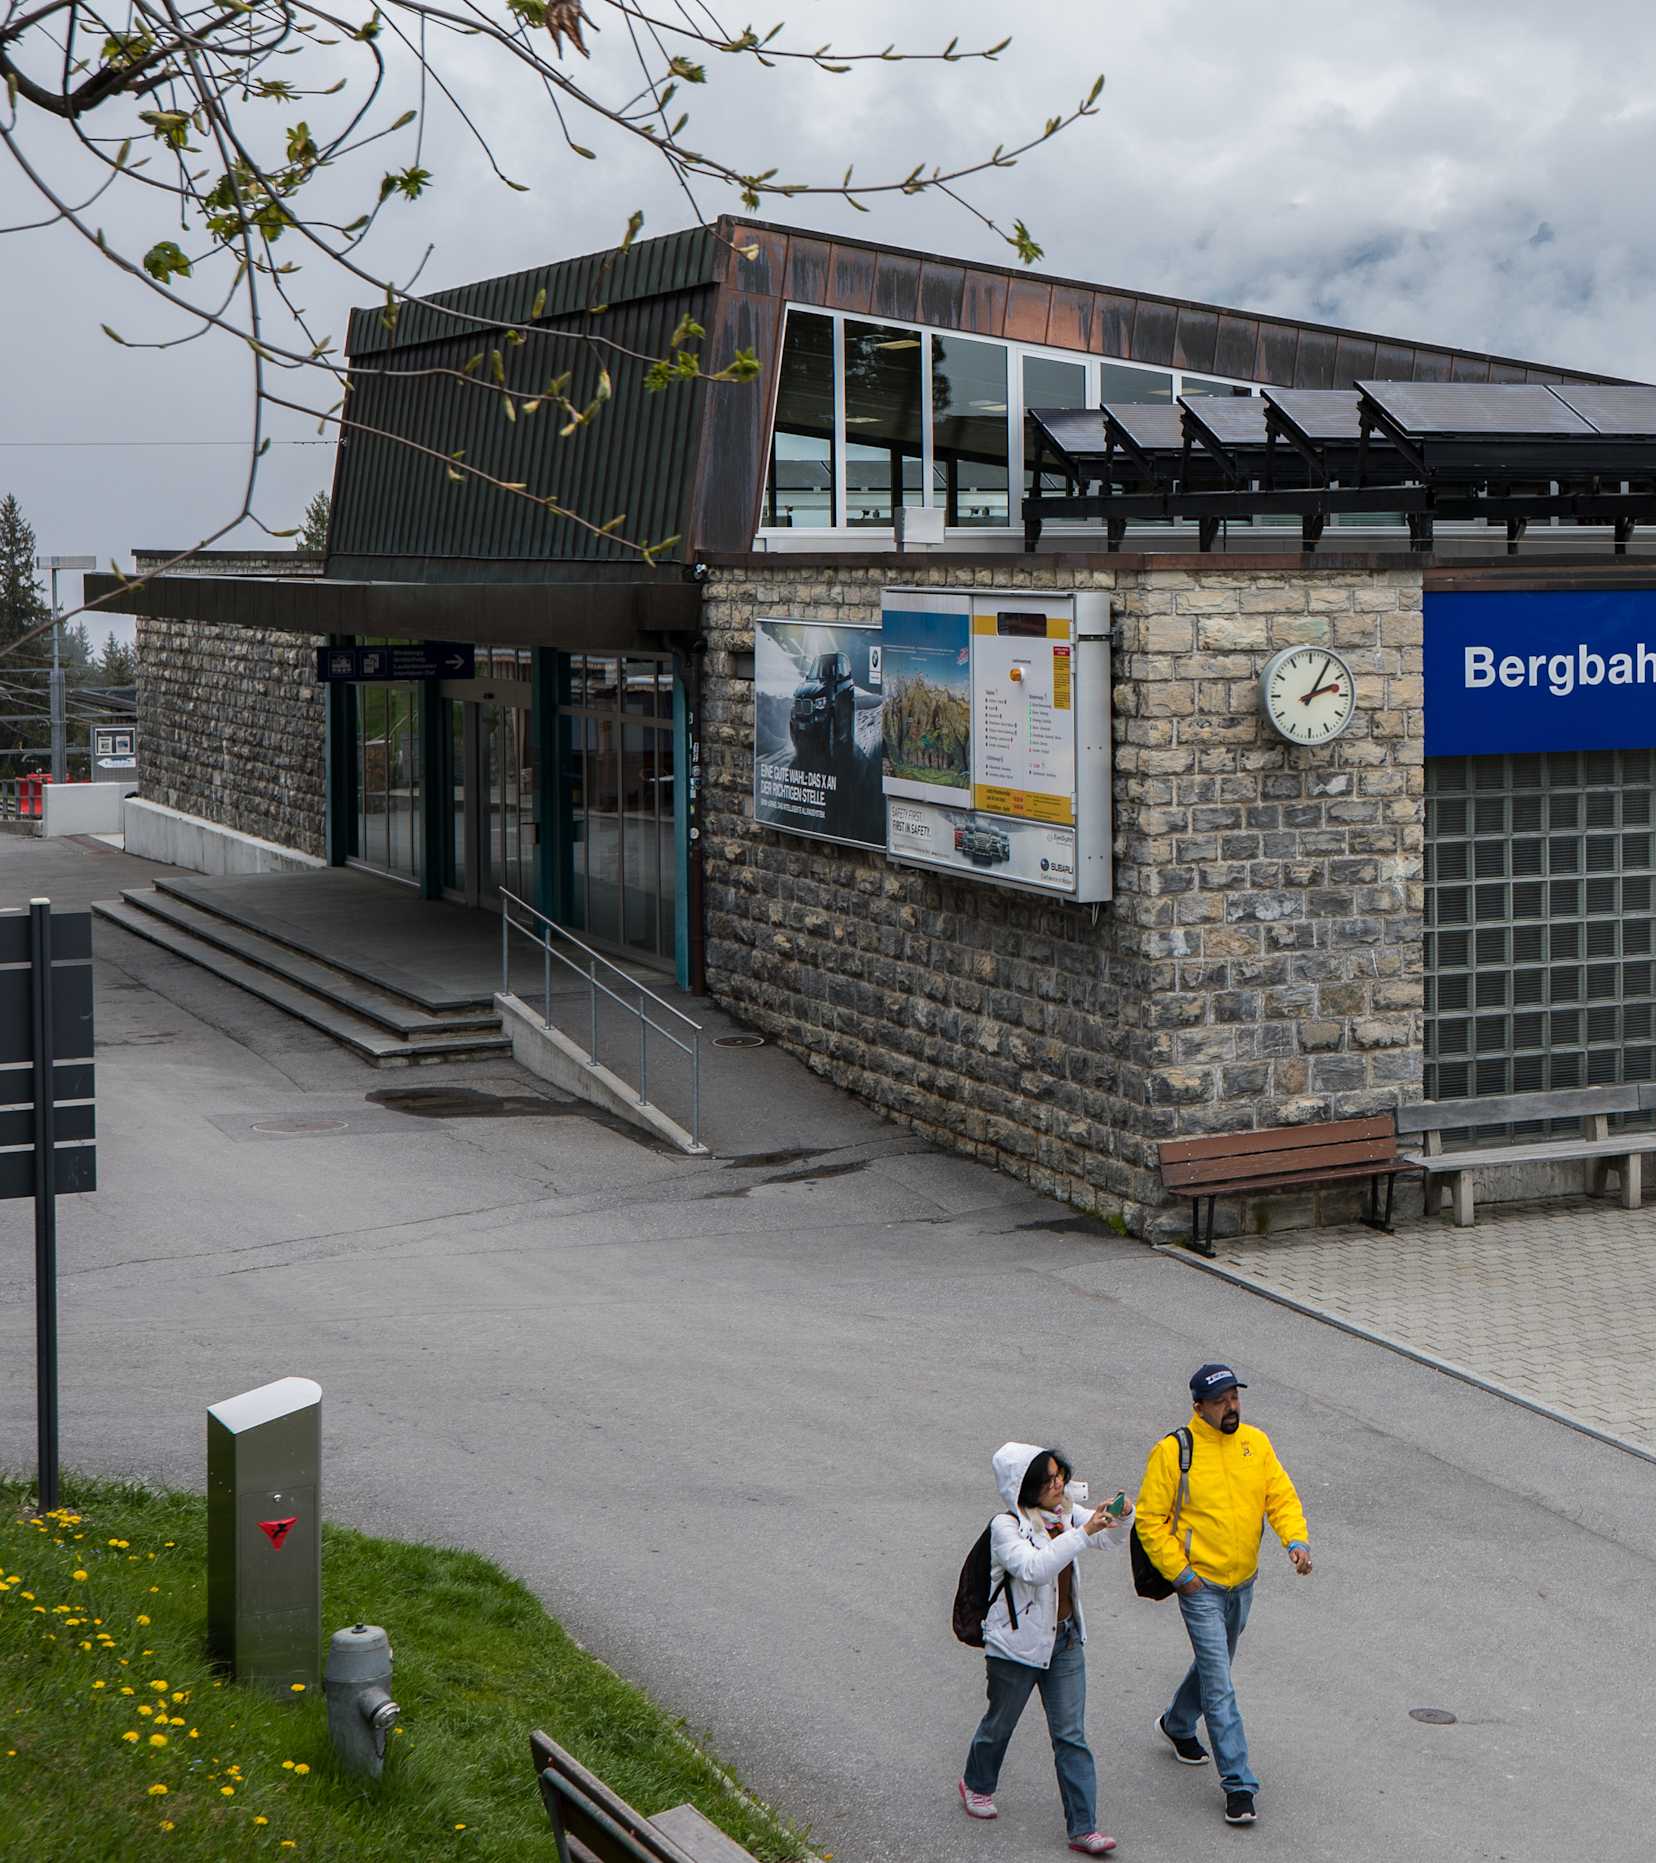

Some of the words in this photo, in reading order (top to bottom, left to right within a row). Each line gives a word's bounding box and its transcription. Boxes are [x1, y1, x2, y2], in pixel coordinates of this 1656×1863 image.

[774, 766, 789, 782] GUTE
[808, 772, 821, 788] DAS
[827, 775, 837, 791] AN
